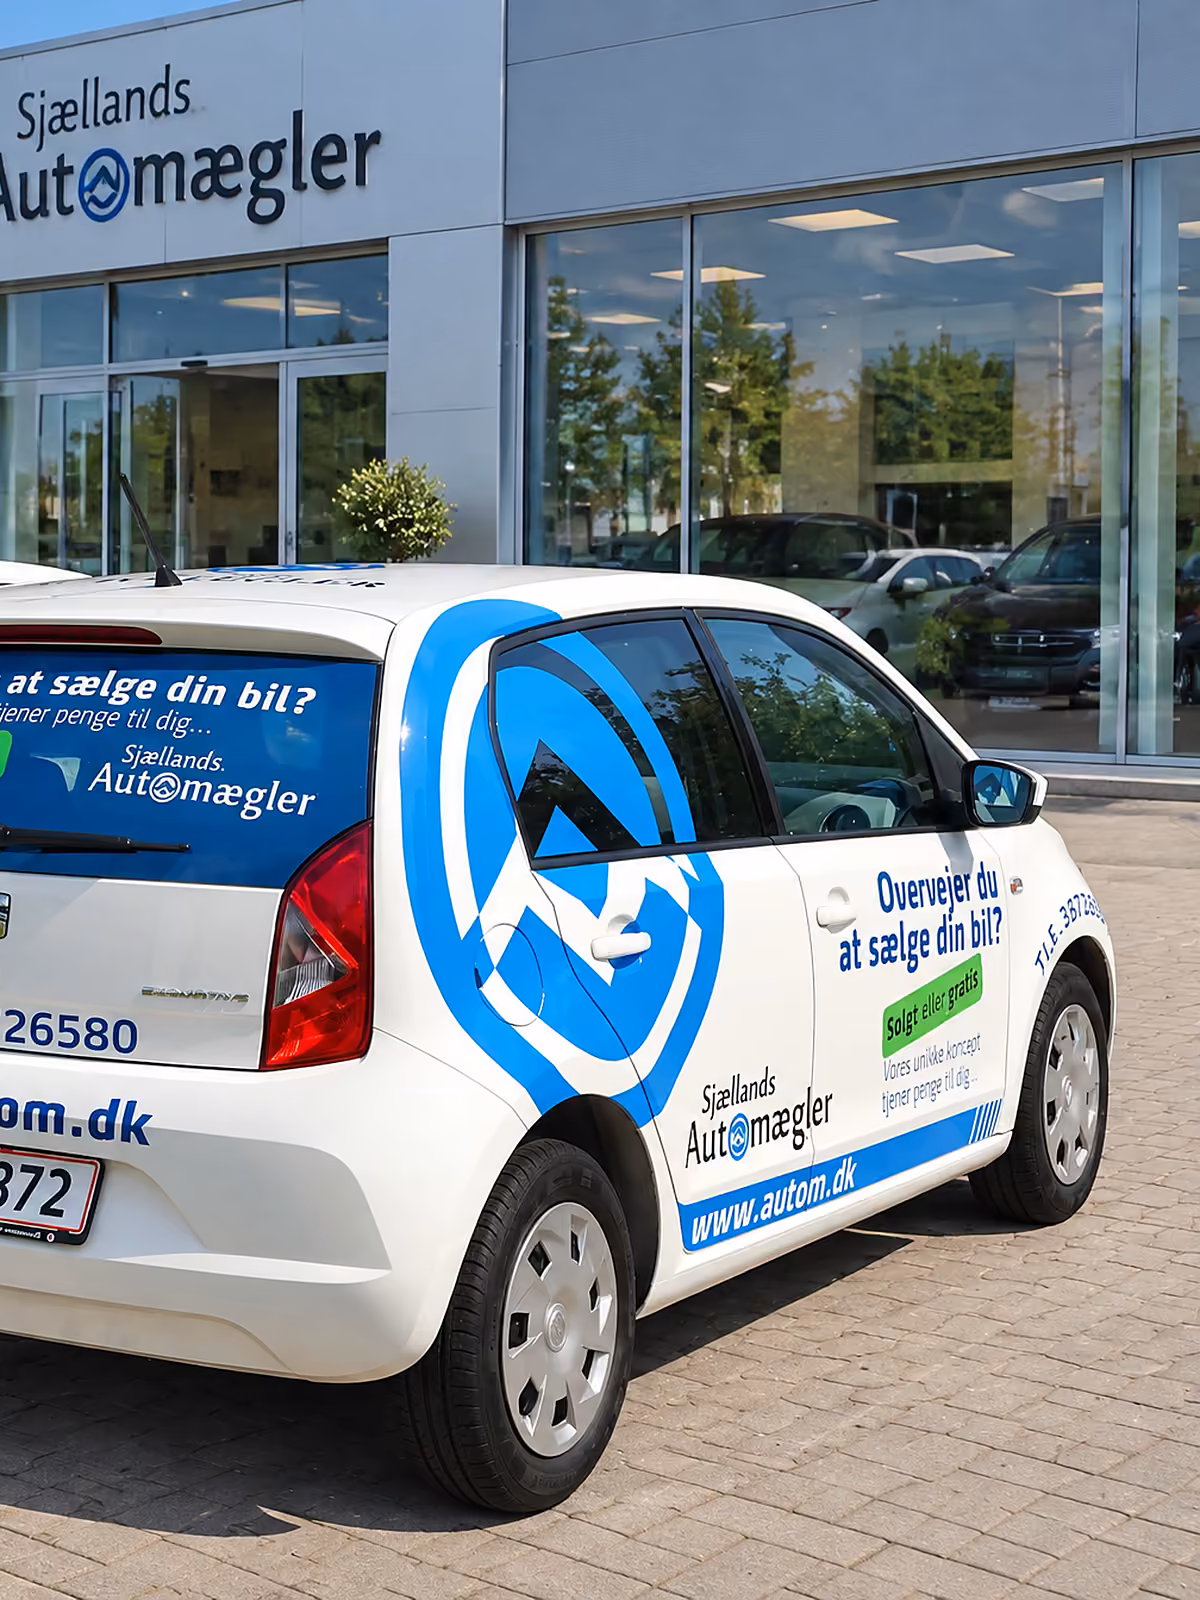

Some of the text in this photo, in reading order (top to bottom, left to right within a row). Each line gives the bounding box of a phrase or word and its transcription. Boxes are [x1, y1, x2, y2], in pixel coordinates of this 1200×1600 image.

[17, 64, 190, 151] Sjællands
[6, 670, 44, 695] at
[49, 670, 157, 705] sælge
[166, 675, 227, 706] din
[237, 681, 317, 714] bil?
[52, 707, 120, 731] penge
[126, 708, 151, 729] til
[156, 709, 211, 738] dig...
[87, 762, 315, 820] Automægler
[877, 861, 999, 913] Overvejer du
[839, 906, 1002, 973] at sælge din bil?
[887, 968, 978, 1041] Solgt eller gratis
[884, 1059, 911, 1081] Vores
[913, 1045, 944, 1072] unikke
[701, 1066, 775, 1120] Sjællands
[685, 1086, 833, 1168] Automægler
[692, 1156, 857, 1245] www.autom.dk
